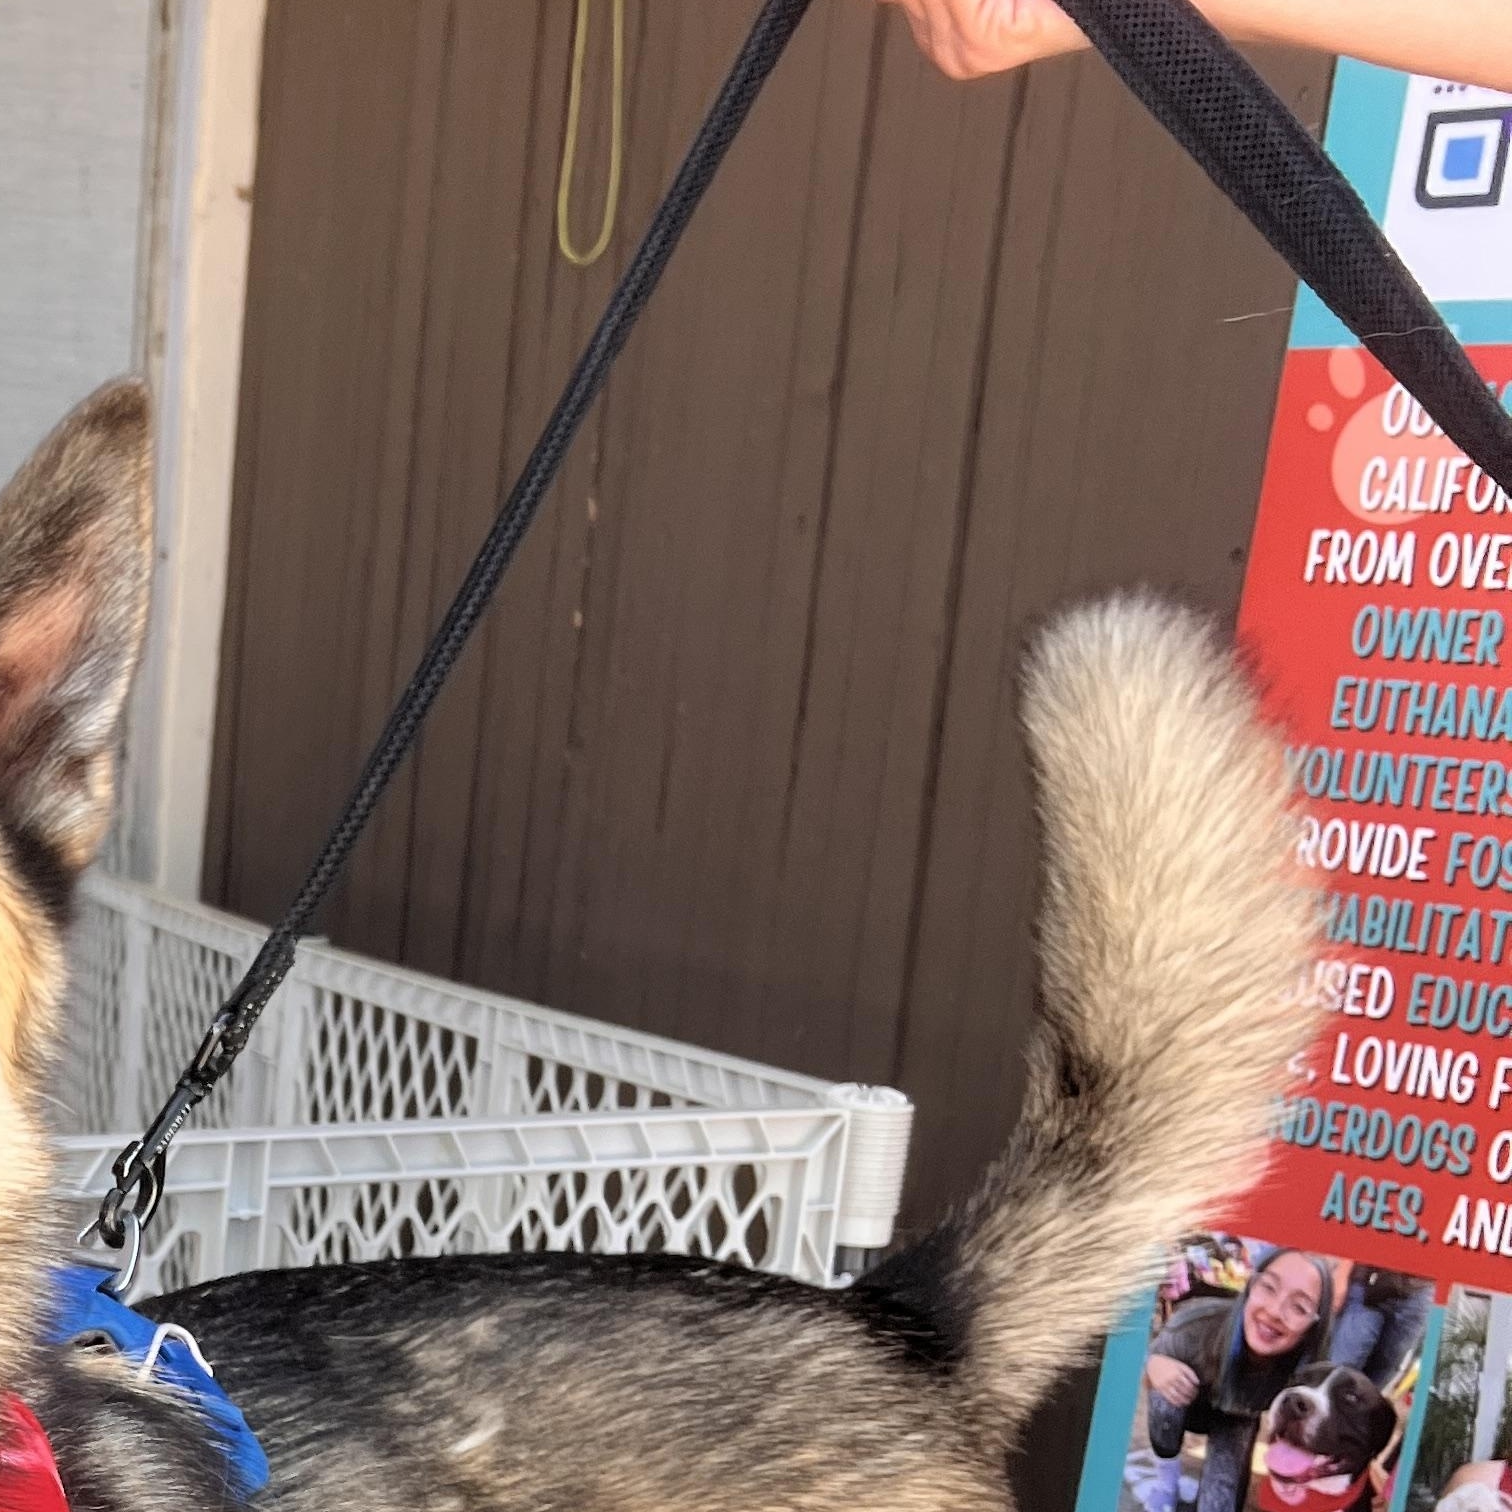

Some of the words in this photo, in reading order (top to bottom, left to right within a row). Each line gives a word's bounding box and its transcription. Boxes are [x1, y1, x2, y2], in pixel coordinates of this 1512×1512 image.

[1381, 381, 1445, 437] OU
[1303, 528, 1417, 586] FROM
[1429, 531, 1512, 590] OVE
[1351, 604, 1504, 665] OWNER
[1330, 675, 1512, 741] EUTHANA
[1295, 815, 1436, 882] ROVIDE
[1331, 1032, 1479, 1104] LOVING
